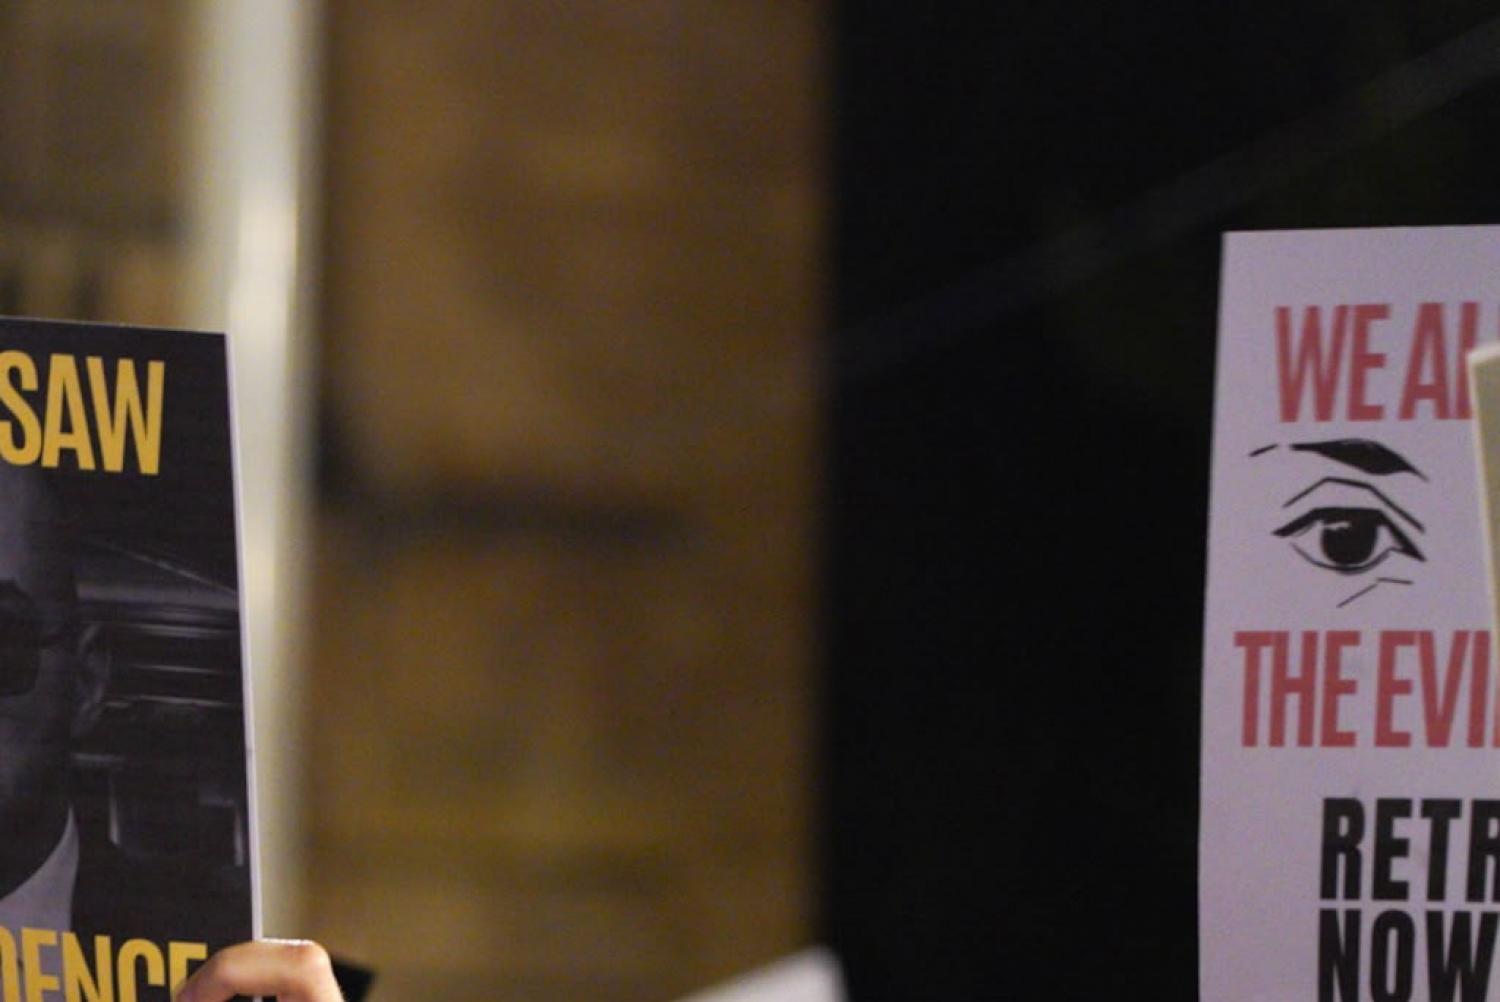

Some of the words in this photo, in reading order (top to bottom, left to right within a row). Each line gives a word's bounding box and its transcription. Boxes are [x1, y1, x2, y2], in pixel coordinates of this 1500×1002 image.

[1273, 303, 1391, 424] WE
[1234, 630, 1361, 748] THE
[1373, 630, 1500, 748] EVI
